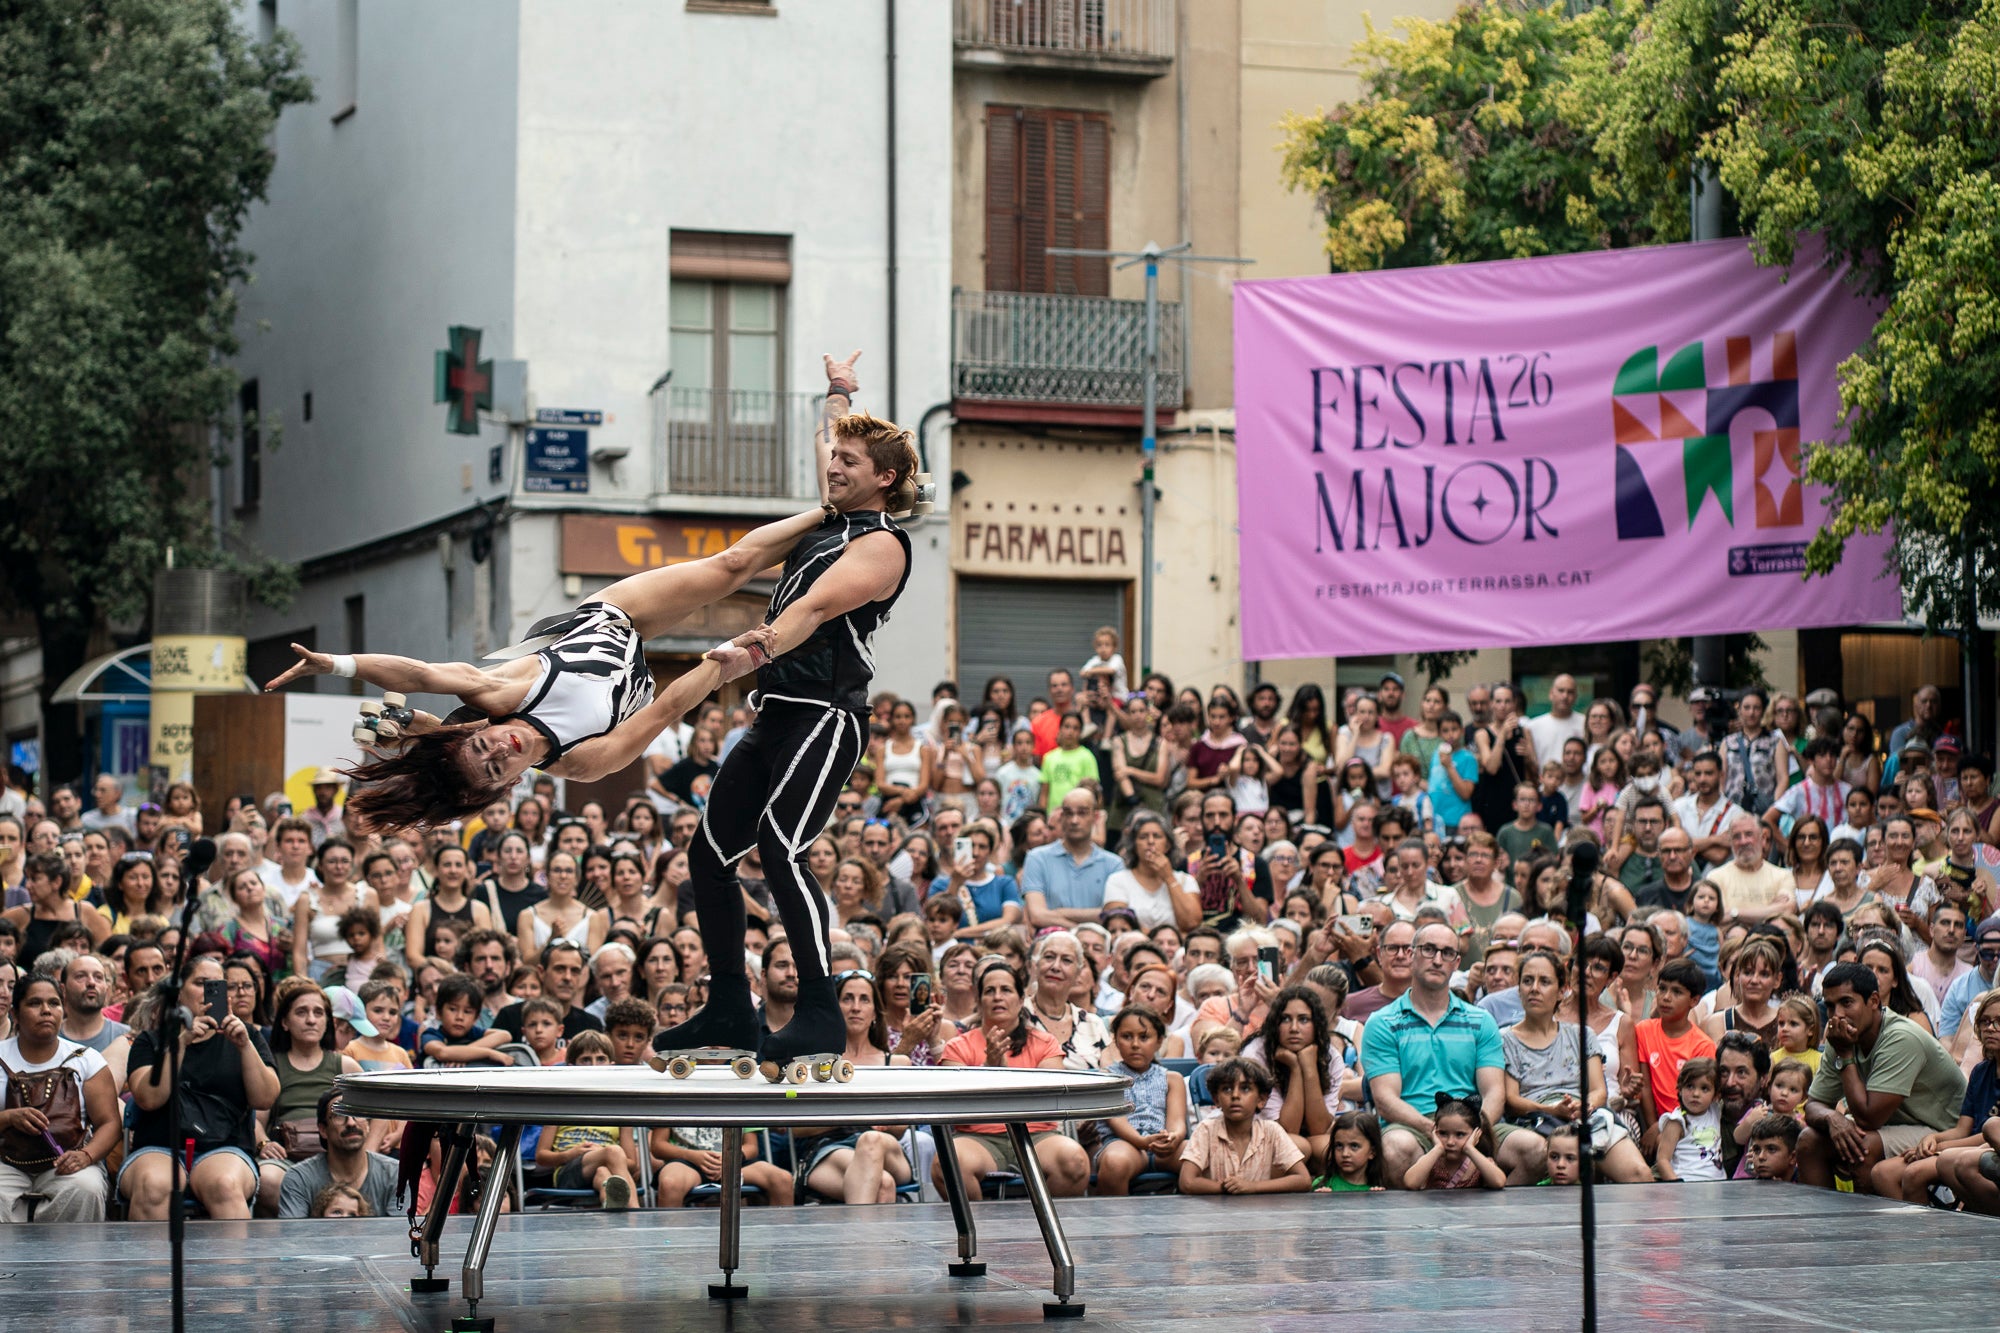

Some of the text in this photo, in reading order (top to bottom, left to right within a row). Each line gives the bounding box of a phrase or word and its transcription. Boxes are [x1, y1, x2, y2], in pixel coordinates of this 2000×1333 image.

[1314, 456, 1559, 553] MAJOR
[965, 522, 1127, 566] FARMACIA
[1315, 569, 1594, 600] FESTAMAJORTERRASSA.CAT
[156, 646, 188, 660] LOVE
[154, 662, 192, 676] LOCAL
